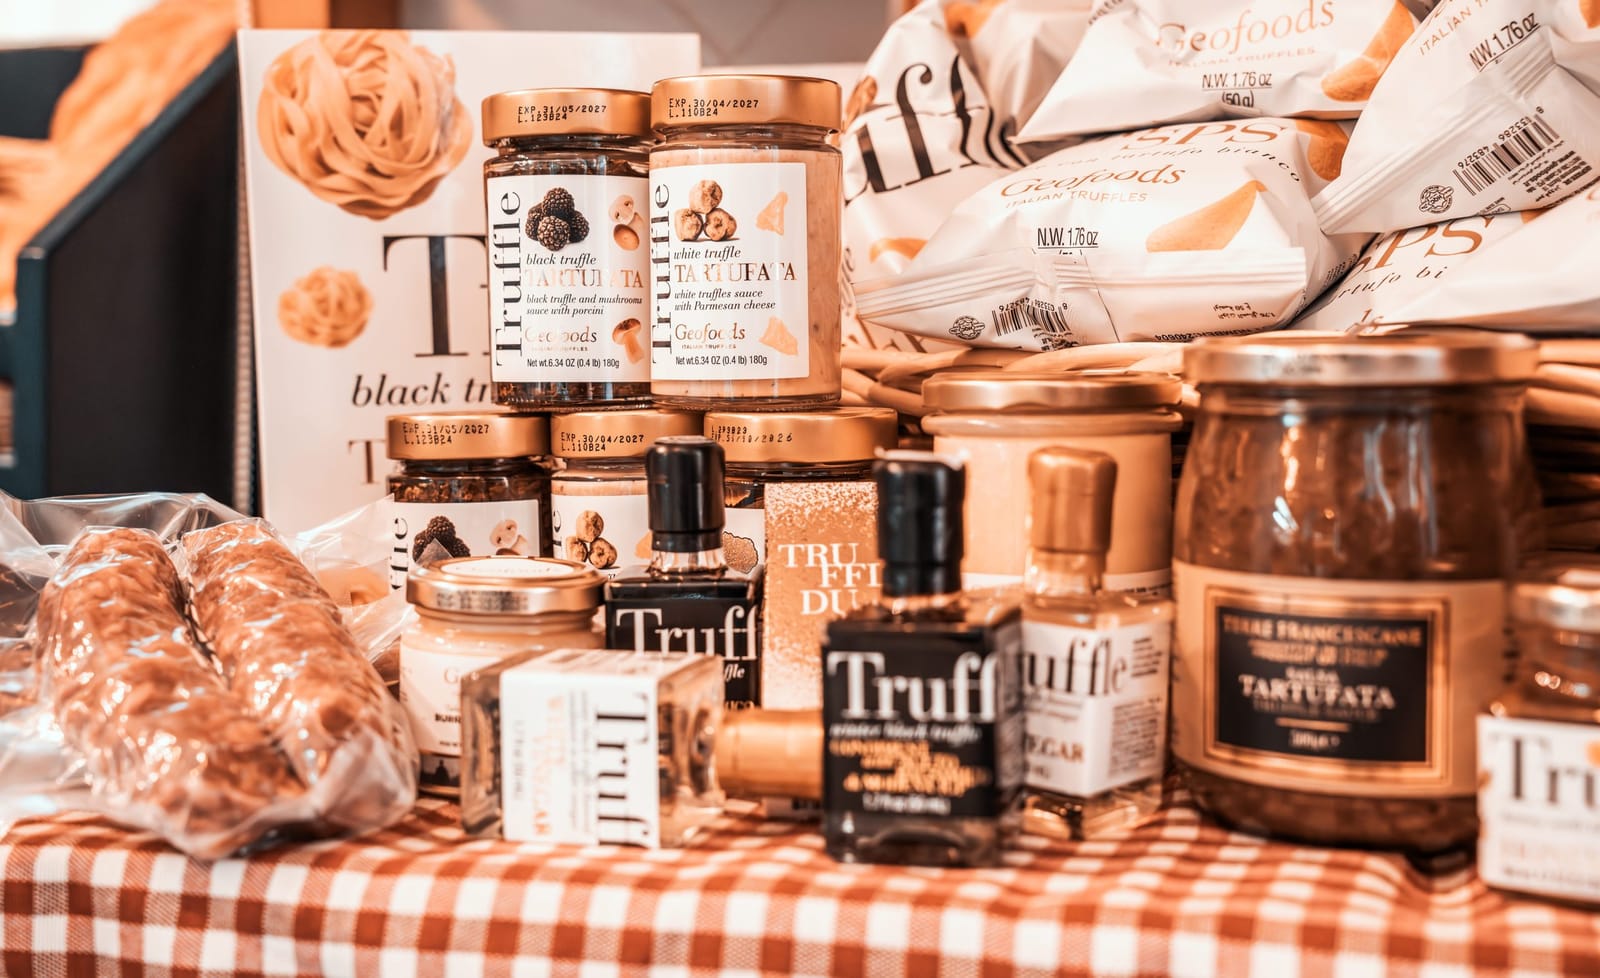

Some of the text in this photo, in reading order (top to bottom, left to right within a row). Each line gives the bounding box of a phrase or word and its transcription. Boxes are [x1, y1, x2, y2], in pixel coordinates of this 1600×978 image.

[1492, 20, 1525, 51] 1.76
[1202, 72, 1273, 89] N.W. 1.76 oz
[518, 105, 607, 116] EXP.31/05/2027
[669, 98, 759, 110] EXP.30/04/2027
[1457, 145, 1490, 169] 483276
[1001, 164, 1186, 198] Geofoods
[1069, 190, 1148, 202] TRUFFLES
[1037, 228, 1099, 246] N.W. 1.76 oz
[526, 253, 597, 268] black truffle
[674, 246, 741, 261] white truffle
[493, 191, 523, 367] Truffle
[651, 183, 672, 363] Truffle
[526, 293, 548, 304] black
[550, 293, 576, 306] truffle
[578, 294, 596, 304] and
[674, 288, 763, 301] white truffles sauce
[526, 306, 604, 318] sauce with porcini
[674, 300, 776, 311] with Parmesan cheese
[527, 359, 539, 368] Net
[565, 359, 575, 368] OZ
[576, 358, 590, 369] (0.4
[591, 358, 601, 368] lb)
[603, 358, 620, 369] 180g
[675, 356, 685, 365] Net
[711, 356, 721, 364] OZ
[722, 355, 736, 366] (0.4
[737, 355, 748, 365] lb)
[750, 355, 768, 366] 180g
[352, 373, 450, 407] black
[777, 543, 859, 568] TRU
